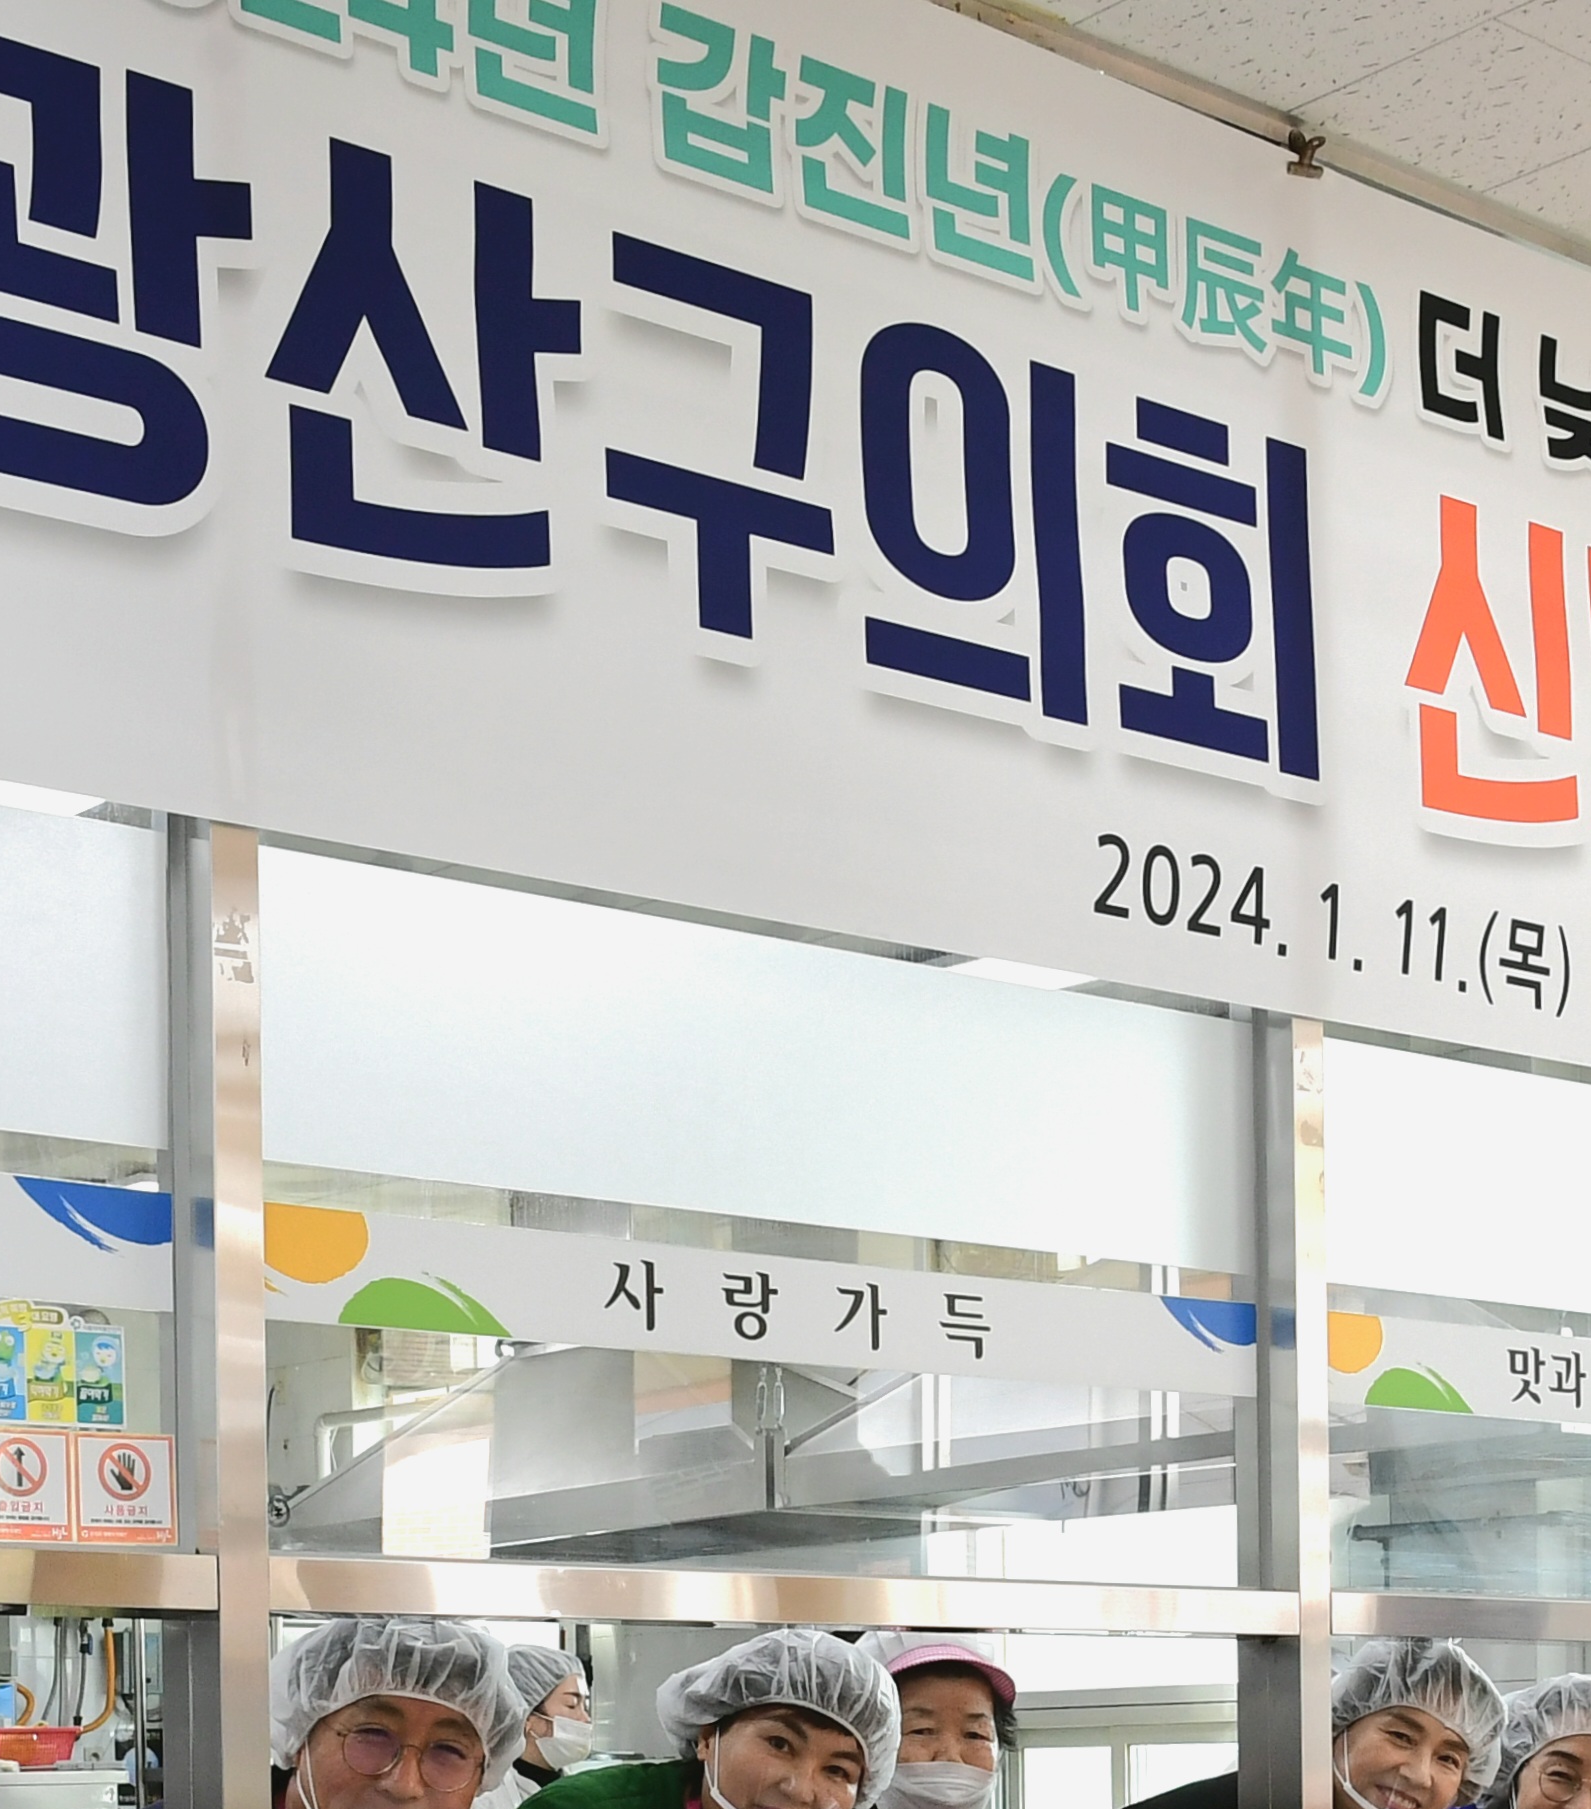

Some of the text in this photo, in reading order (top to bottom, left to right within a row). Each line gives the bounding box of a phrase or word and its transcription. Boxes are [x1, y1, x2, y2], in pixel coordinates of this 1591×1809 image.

[657, 3, 1390, 398] 갑진년(甲辰年)
[1417, 290, 1506, 441] 더
[1093, 832, 1288, 958] 2024.
[1319, 882, 1363, 973] 1.
[1507, 1347, 1587, 1409] 맛과
